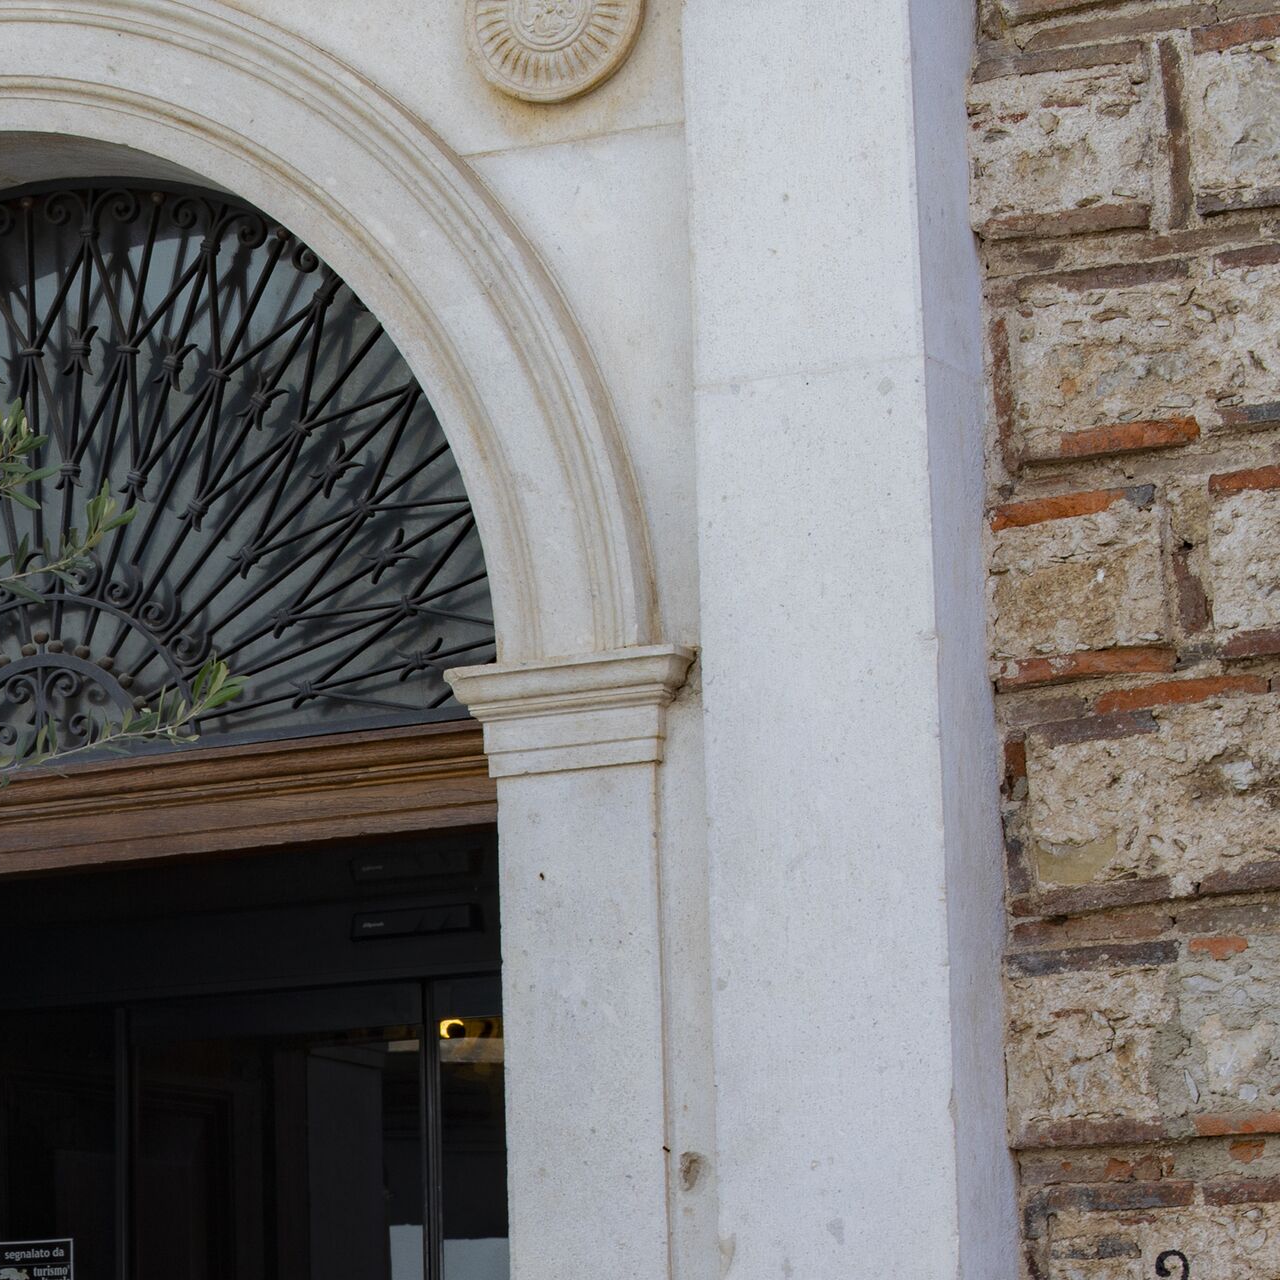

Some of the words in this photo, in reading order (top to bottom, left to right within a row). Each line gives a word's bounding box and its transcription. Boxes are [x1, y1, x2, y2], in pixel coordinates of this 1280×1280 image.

[4, 1248, 50, 1262] segnalato
[52, 1247, 65, 1257] da
[33, 1265, 68, 1277] turismo
